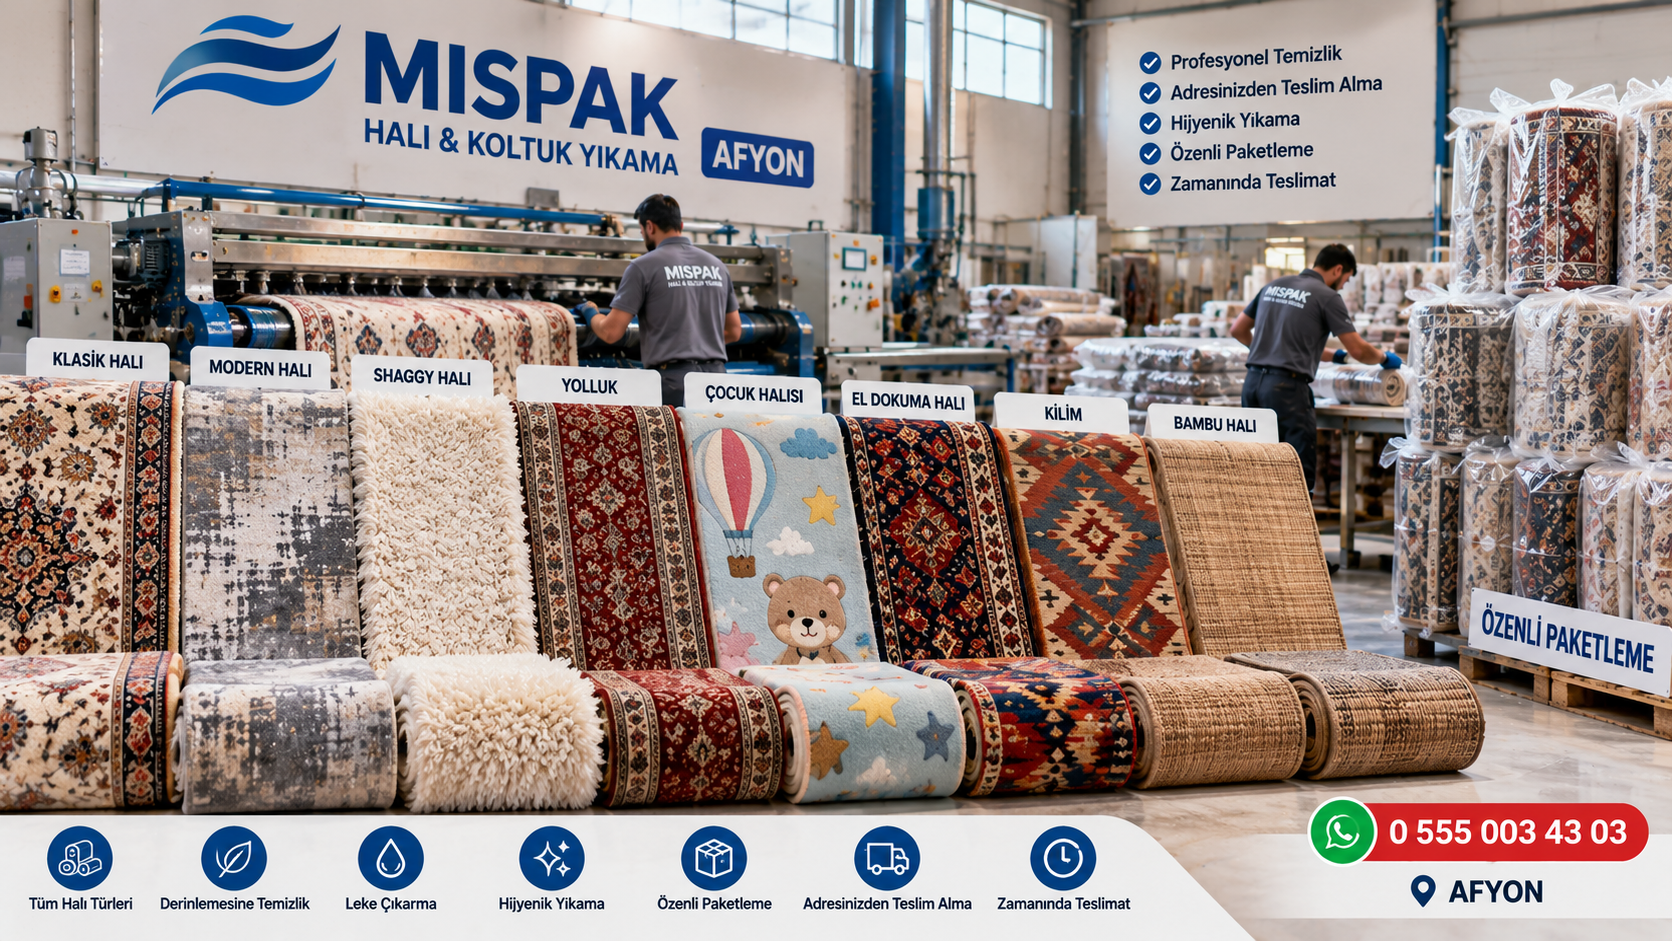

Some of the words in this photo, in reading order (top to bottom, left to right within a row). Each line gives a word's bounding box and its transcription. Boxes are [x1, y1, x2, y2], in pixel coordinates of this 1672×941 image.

[1171, 48, 1269, 72] Profesyonel
[1273, 44, 1343, 64] Temizlik
[364, 30, 680, 141] MISPAK
[1170, 80, 1277, 101] Adresinizden
[1280, 77, 1335, 96] Teslim
[1338, 75, 1383, 93] Alma
[1171, 113, 1236, 135] Hijyenik
[364, 117, 430, 150] HALI
[438, 126, 459, 154] &
[468, 130, 573, 166] KOLTUK
[579, 143, 679, 176] YIKAMA
[1170, 141, 1221, 162] Özenli
[1226, 141, 1314, 160] Paketleme
[712, 139, 804, 178] AFYON
[1170, 173, 1262, 192] Zamanında
[1265, 171, 1337, 189] Teslimat
[663, 265, 722, 281] MISPAK
[1265, 286, 1311, 303] MISPAK
[52, 349, 106, 368] KLASİK
[109, 353, 143, 370] HALI
[209, 359, 275, 376] MODERN
[278, 362, 312, 378] HALI
[373, 367, 435, 385] SHAGGY
[438, 370, 471, 386] HALI
[561, 377, 618, 395] YOLLUK
[705, 384, 756, 403] ÇOCUK
[758, 387, 804, 404] HALISI
[852, 391, 868, 406] EL
[870, 392, 932, 409] DOKUMA
[934, 395, 965, 411] HALI
[1044, 403, 1083, 422] KİLİM
[1174, 415, 1223, 432] BAMBU
[1226, 418, 1257, 433] HALI
[1481, 602, 1542, 647] ÖZENLİ
[1546, 622, 1656, 675] PAKETLEME
